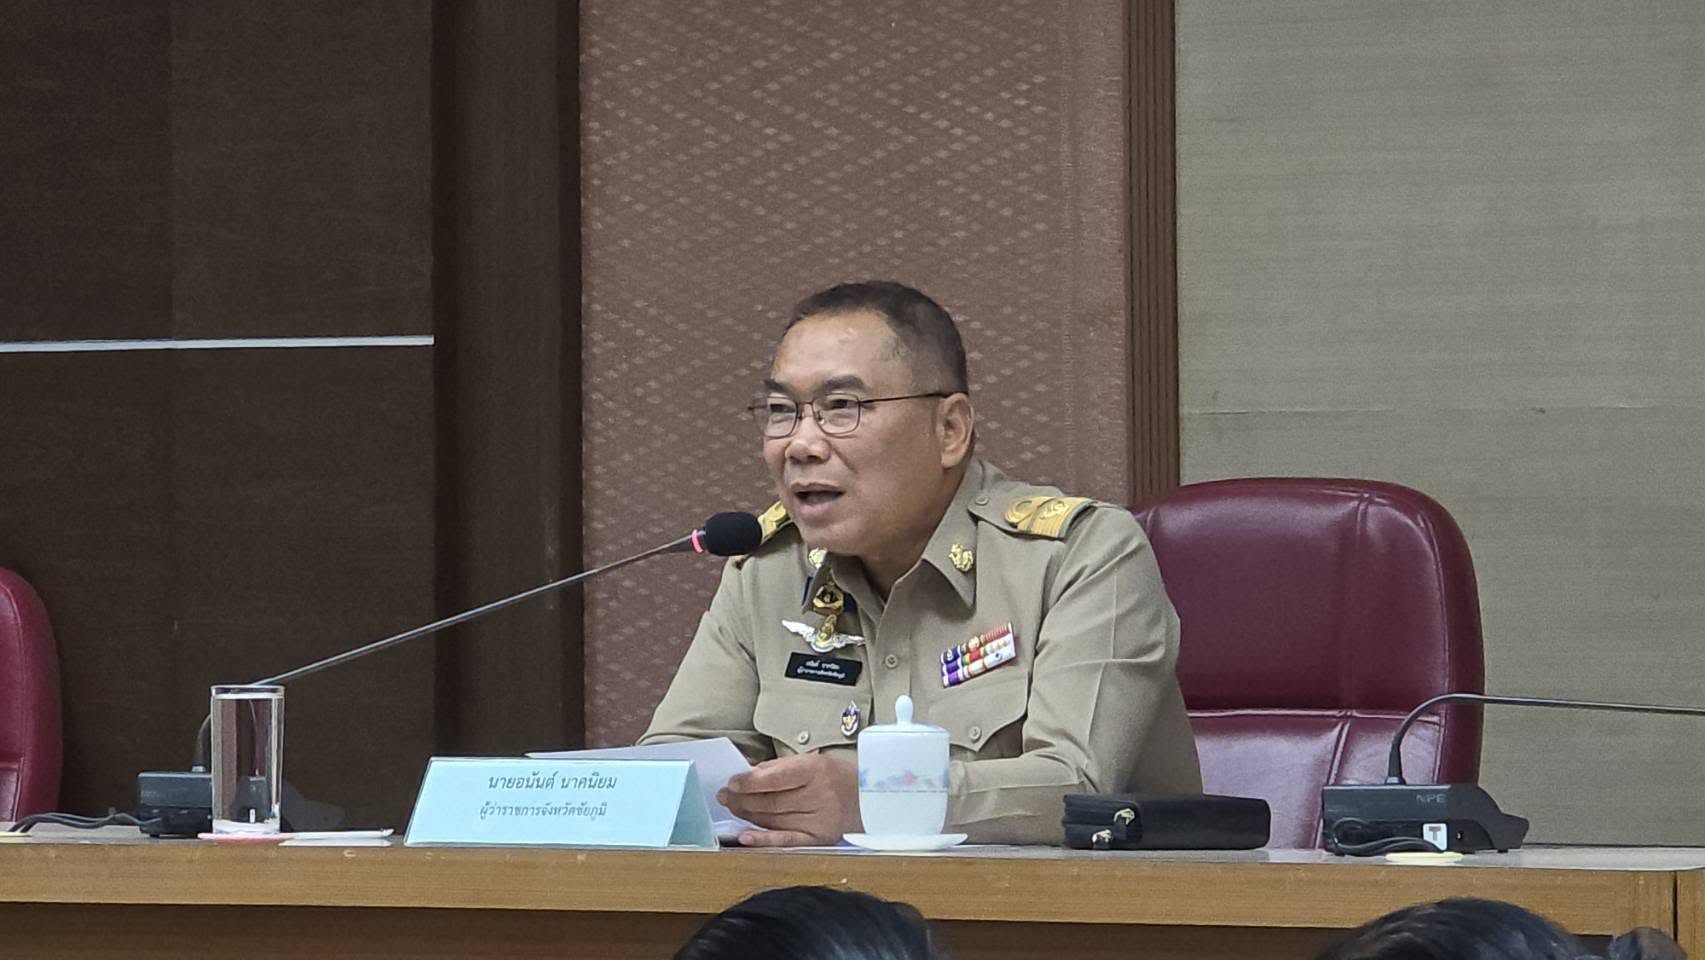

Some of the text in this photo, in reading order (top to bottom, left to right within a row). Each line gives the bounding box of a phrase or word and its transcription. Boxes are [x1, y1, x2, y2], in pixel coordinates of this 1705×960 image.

[488, 770, 618, 789] นายอนันต์ นาคนิยม
[479, 801, 608, 821] ผู้ว่าราชการจังหวัดชัยภูมิ
[1428, 826, 1441, 841] T
